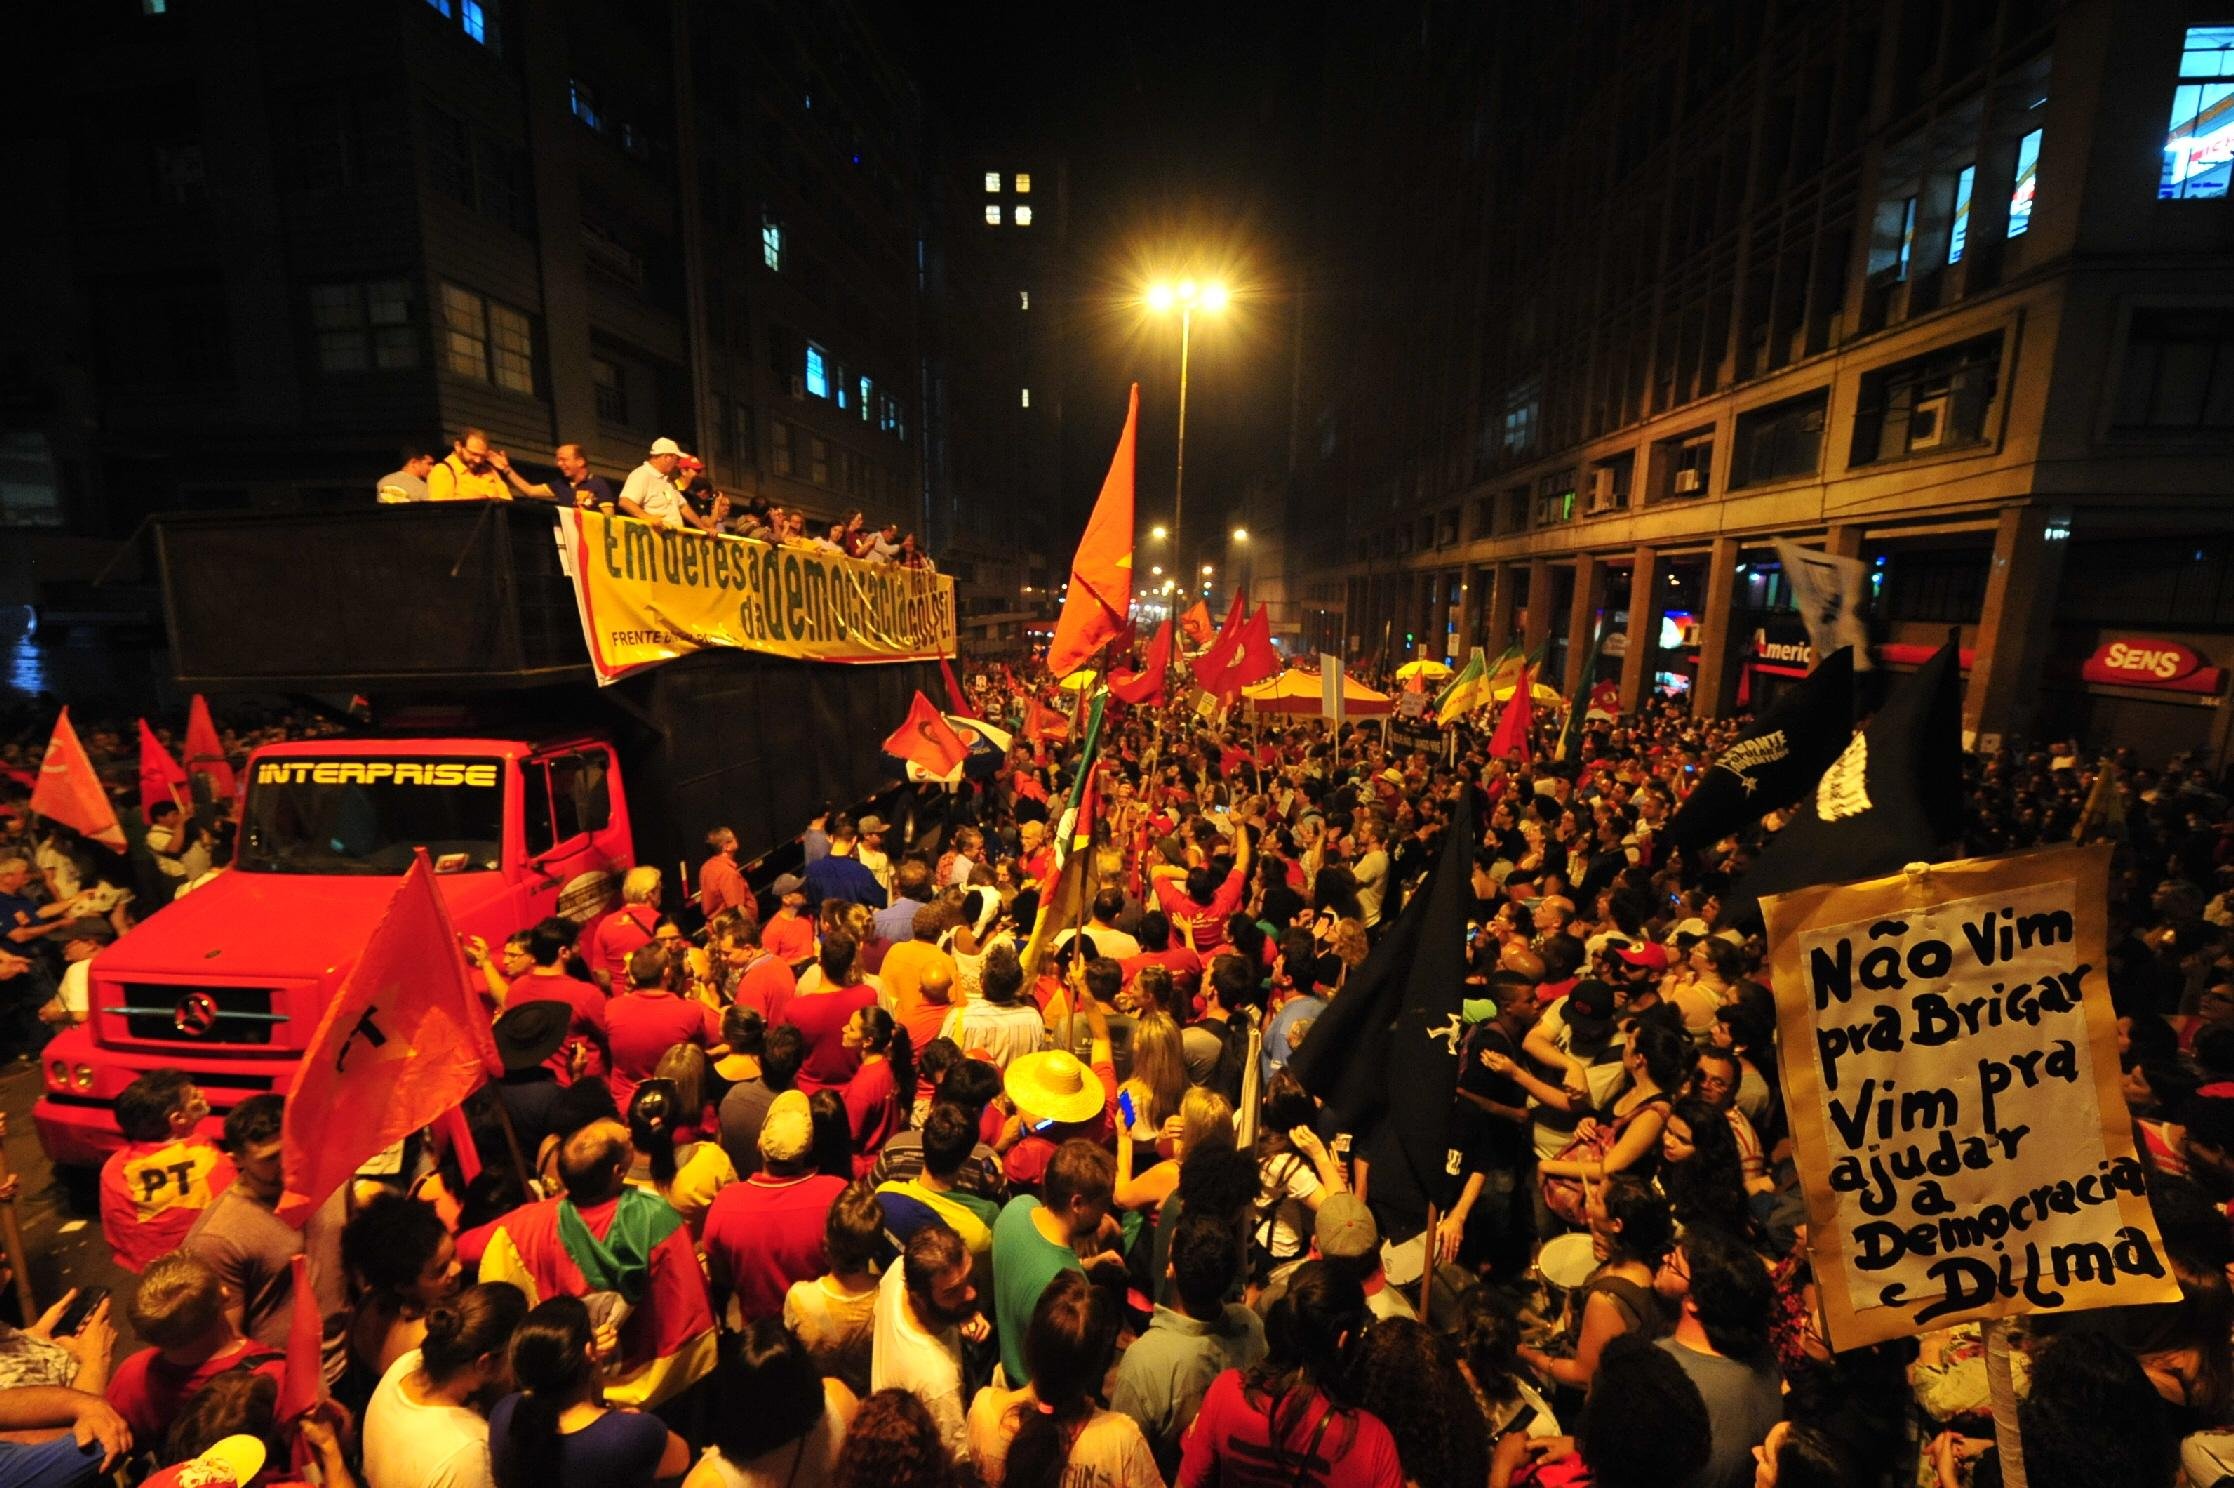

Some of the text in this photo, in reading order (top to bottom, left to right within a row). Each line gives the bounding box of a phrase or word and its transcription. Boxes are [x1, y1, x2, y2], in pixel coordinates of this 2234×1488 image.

[612, 630, 661, 647] FRENTE
[2104, 642, 2181, 677] SENS
[1811, 907, 2073, 1009] Não Vim
[1816, 1006, 1904, 1090] pra
[1829, 1040, 2080, 1150] Vim pra
[140, 1160, 195, 1202] PT
[1829, 1124, 2030, 1216] ajudar
[1852, 1157, 2146, 1271] Democracia
[1911, 1180, 1956, 1216] a
[1913, 1226, 2166, 1326] Dilma
